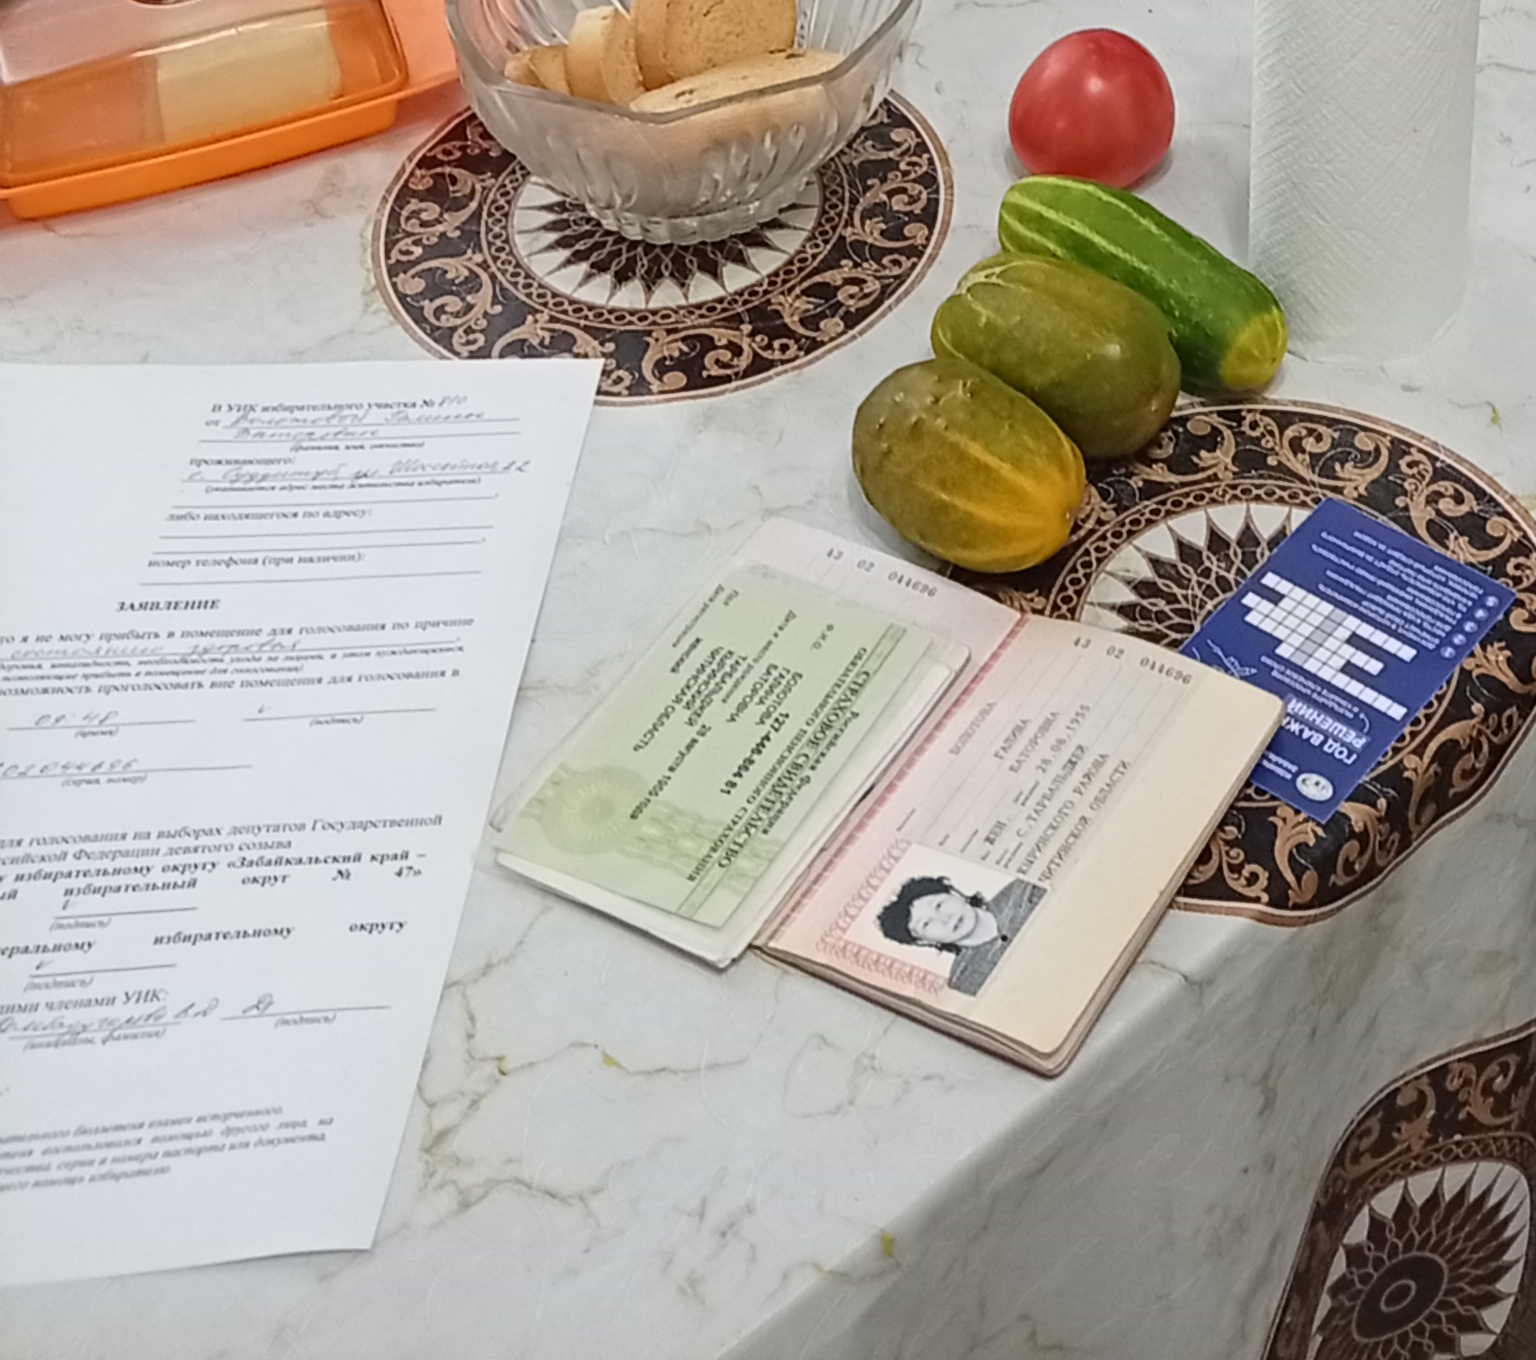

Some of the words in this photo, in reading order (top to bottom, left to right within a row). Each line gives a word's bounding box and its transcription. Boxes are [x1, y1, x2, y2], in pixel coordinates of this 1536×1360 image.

[115, 599, 221, 612] ЗАЯВЛЕНИЕ
[805, 667, 872, 750] СТРАХОВОЕ
[1284, 695, 1368, 752] РЕШЕНИЙ
[1321, 736, 1358, 766] ГОД
[714, 749, 811, 871] СВИДЕТЕЛЬСТВО
[14, 863, 154, 883] избирательному
[161, 859, 220, 873] округу
[226, 852, 362, 870] «Забайкальский
[369, 849, 410, 864] край
[63, 878, 197, 898] избирательный
[241, 873, 291, 888] округ
[153, 924, 294, 947] избирательному
[349, 921, 408, 935] округу
